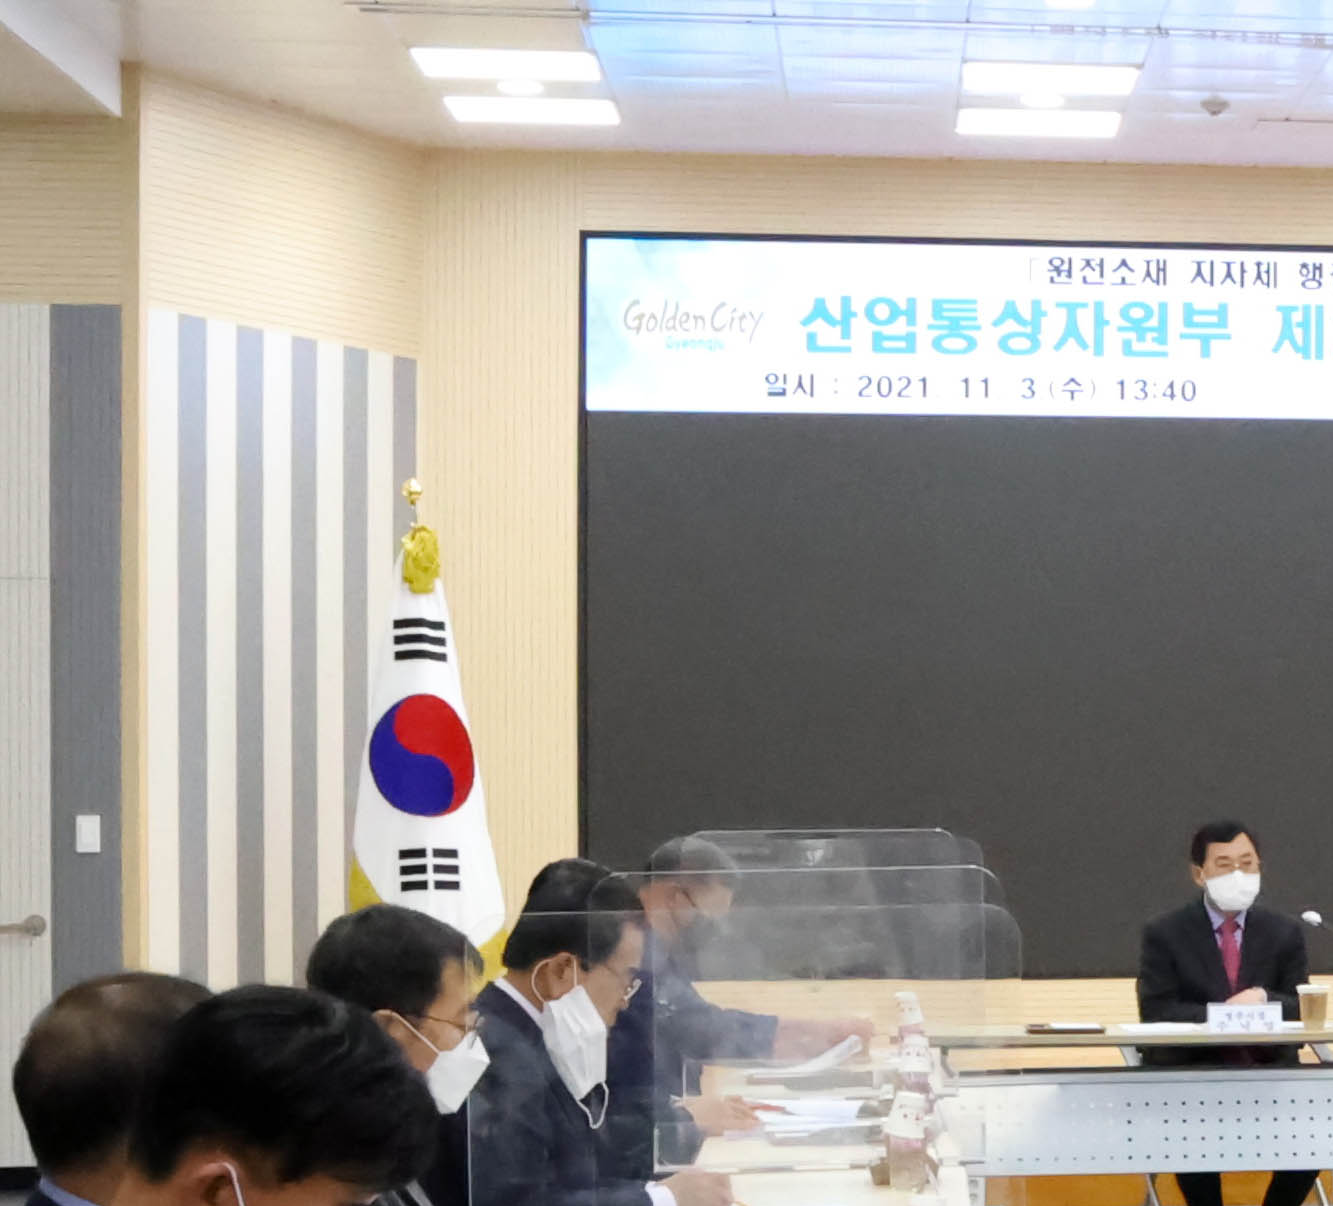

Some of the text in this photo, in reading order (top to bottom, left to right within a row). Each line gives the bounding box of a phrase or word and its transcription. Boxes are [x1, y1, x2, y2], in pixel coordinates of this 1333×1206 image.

[1190, 258, 1279, 289] 지자체
[800, 295, 1232, 359] 산업통상자원부
[764, 372, 815, 398] 일시
[1116, 378, 1198, 402] 13:40
